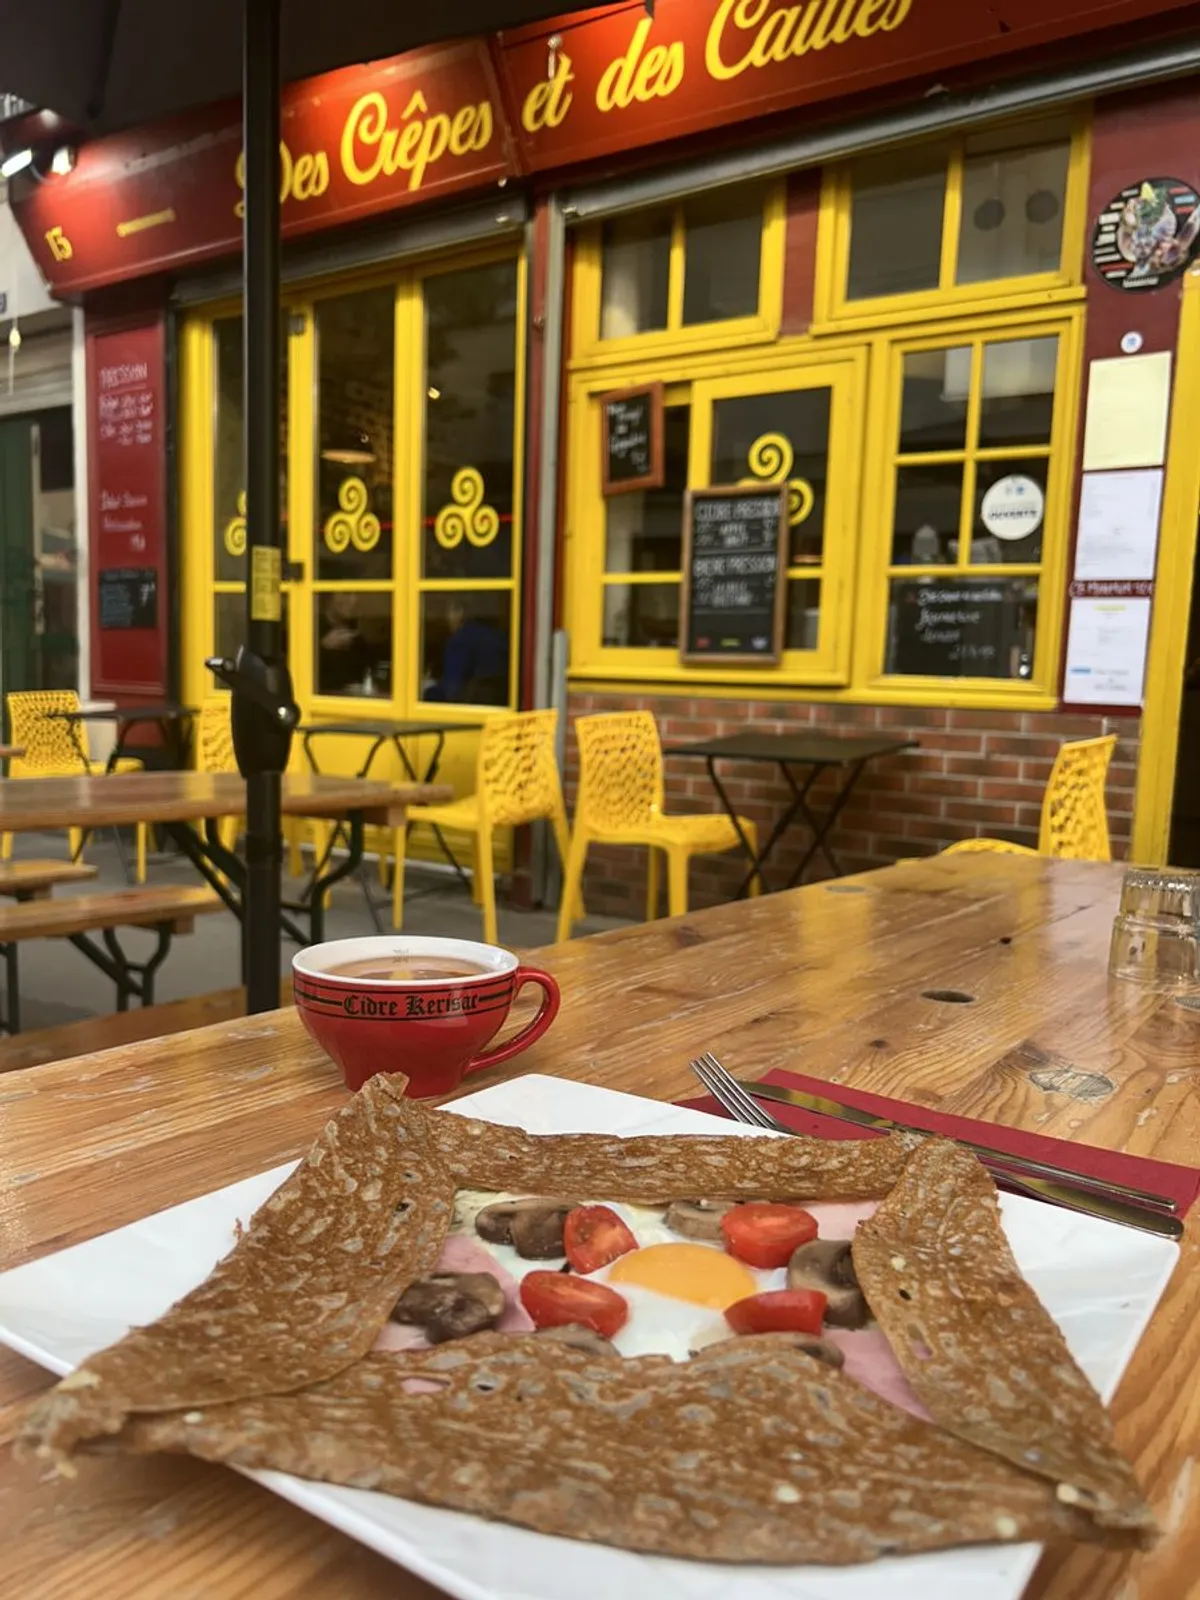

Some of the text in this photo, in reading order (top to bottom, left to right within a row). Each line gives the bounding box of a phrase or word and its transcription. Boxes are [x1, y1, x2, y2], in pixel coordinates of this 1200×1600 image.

[340, 90, 493, 191] Crêpes
[522, 51, 575, 133] et
[595, 16, 685, 112] des
[344, 995, 398, 1016] Cidre
